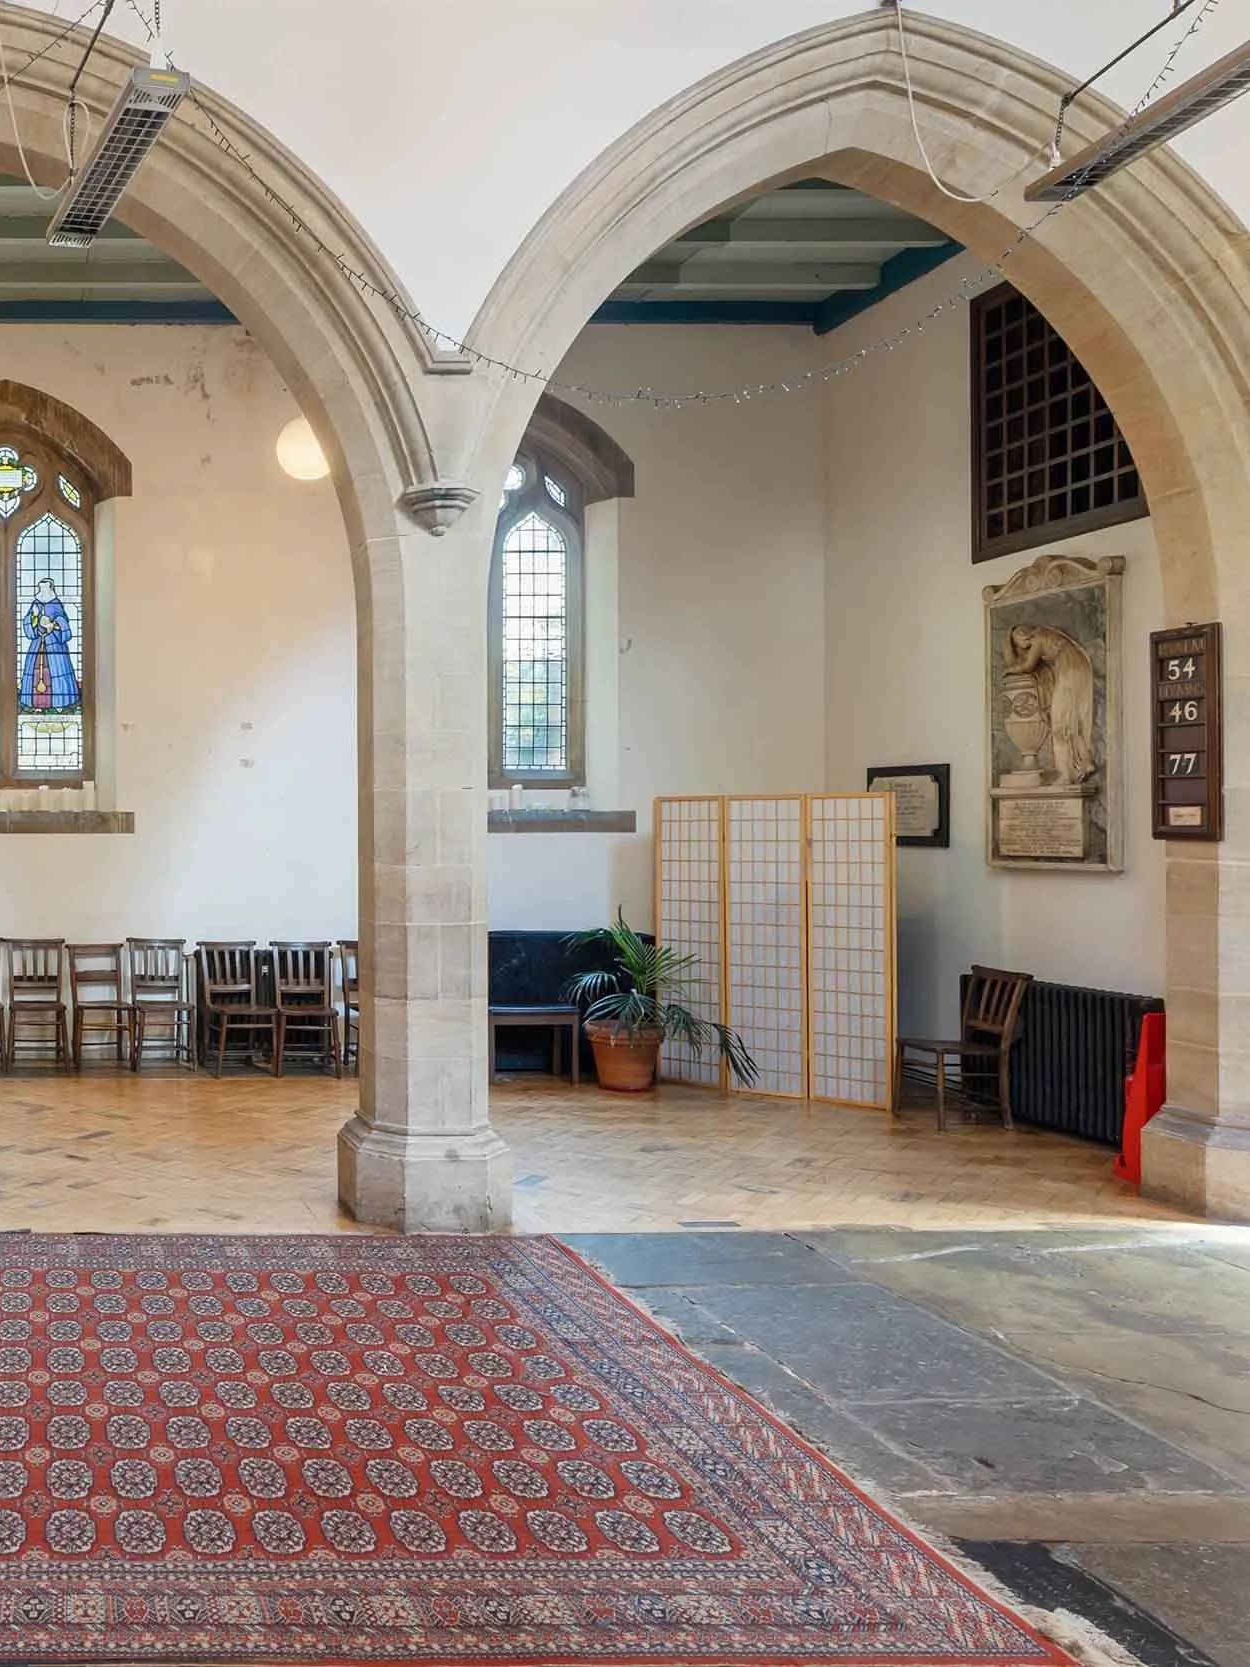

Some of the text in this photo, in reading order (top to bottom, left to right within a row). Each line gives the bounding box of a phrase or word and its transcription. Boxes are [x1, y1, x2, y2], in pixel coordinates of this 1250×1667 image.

[1168, 657, 1196, 680] 54
[1169, 701, 1198, 723] 46
[1169, 753, 1197, 775] 77
